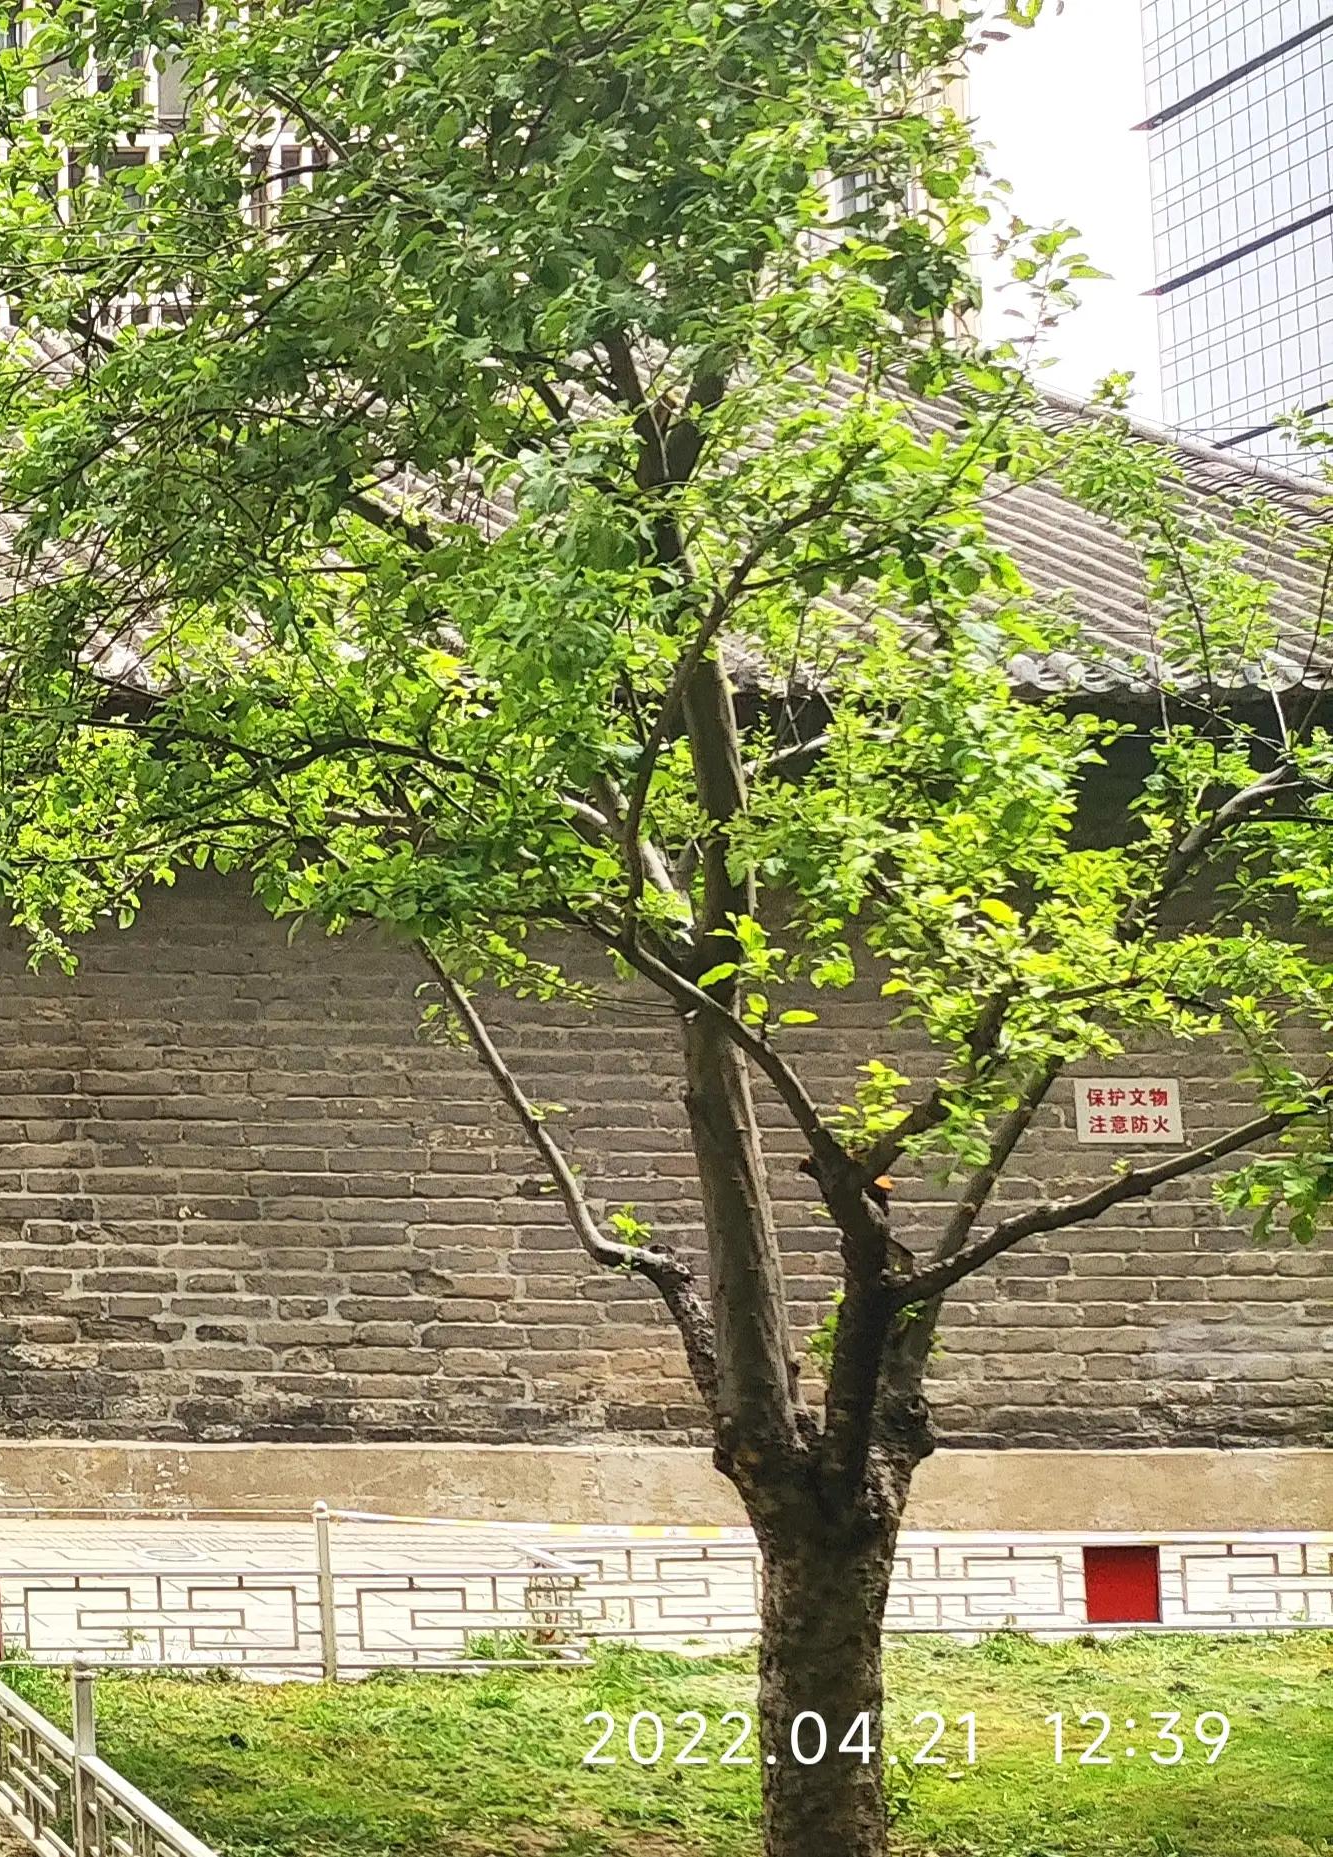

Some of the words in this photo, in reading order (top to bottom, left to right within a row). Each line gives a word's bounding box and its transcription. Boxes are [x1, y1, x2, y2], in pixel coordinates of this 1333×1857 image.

[1086, 1087, 1170, 1107] 保护文物
[1088, 1114, 1172, 1135] 注意防火
